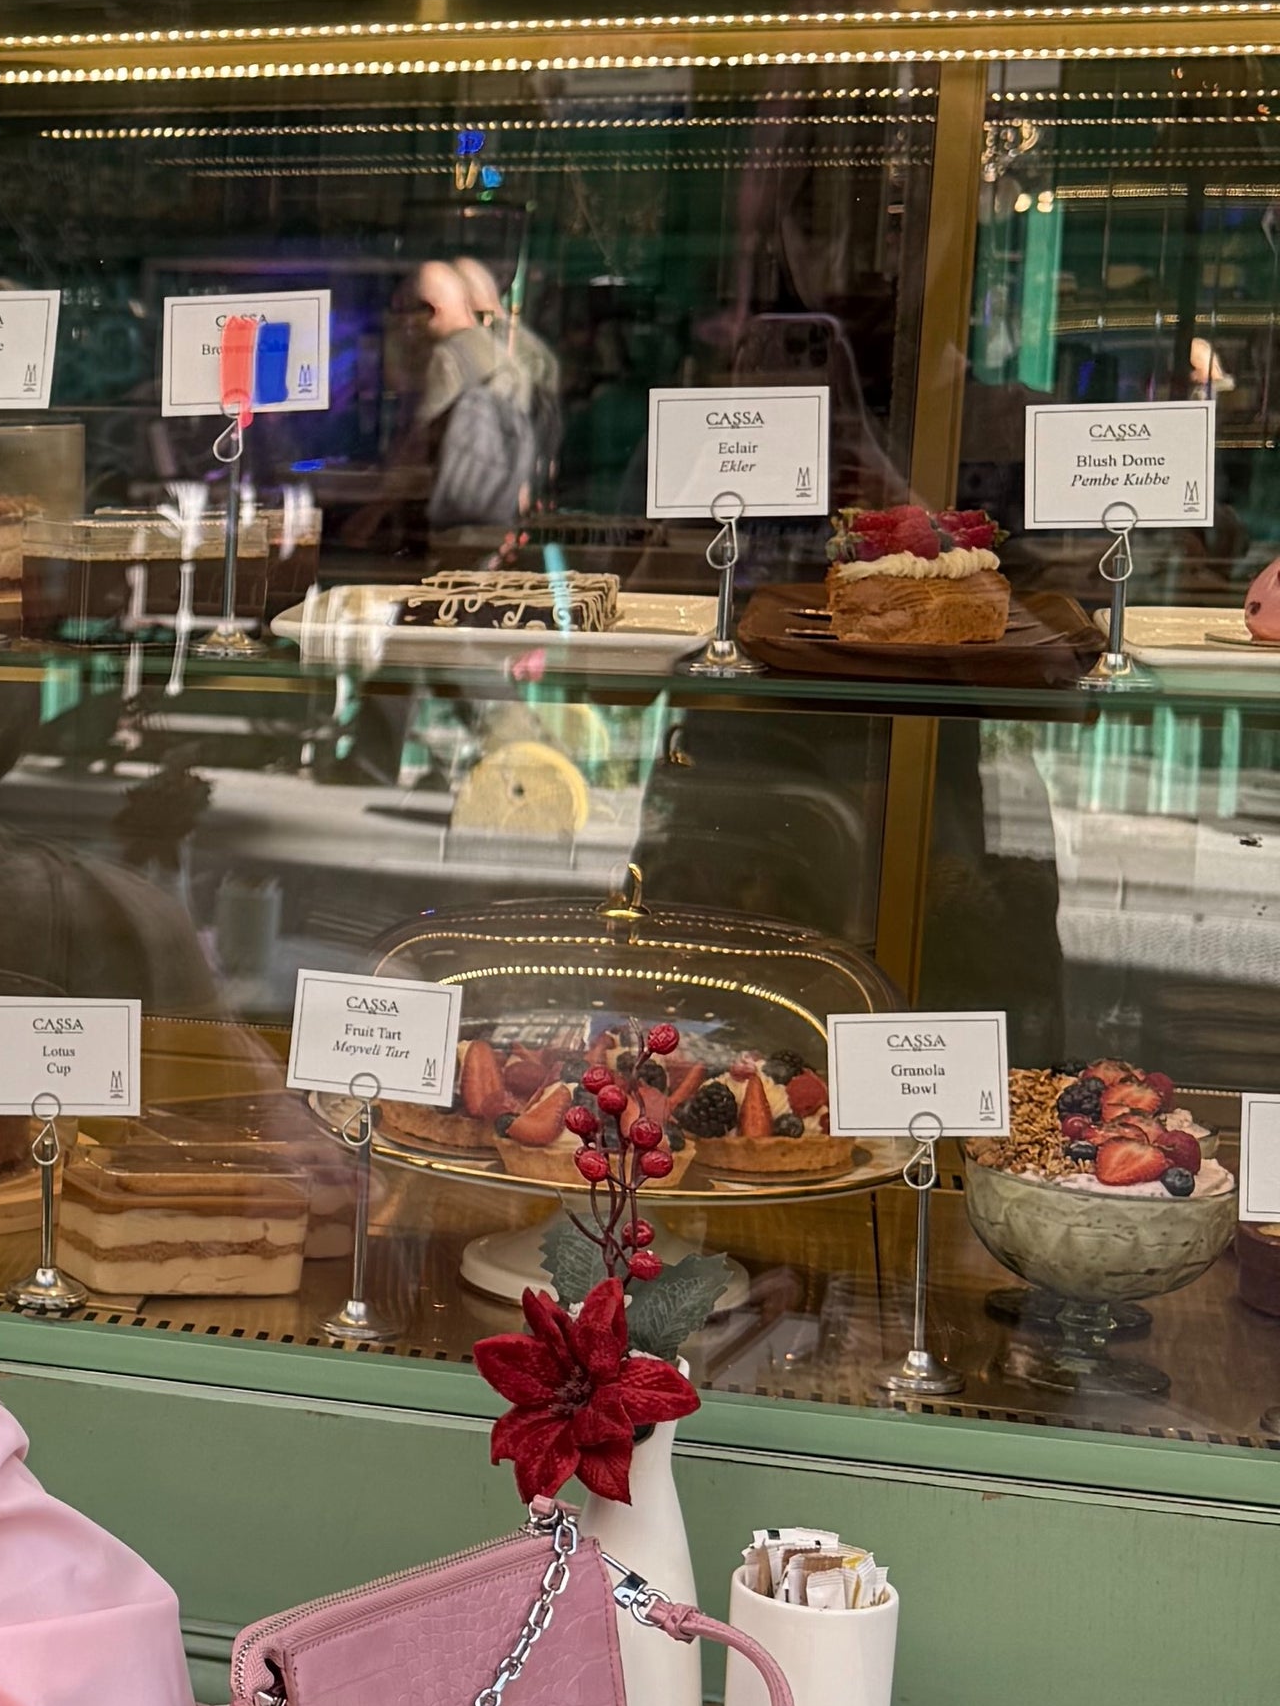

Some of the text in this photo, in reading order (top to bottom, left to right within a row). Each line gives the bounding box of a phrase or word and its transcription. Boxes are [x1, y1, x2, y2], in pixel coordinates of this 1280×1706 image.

[706, 411, 765, 429] CASSA
[1089, 423, 1151, 441] CASSA
[718, 442, 758, 454] Eclair
[719, 460, 756, 473] Ekler
[1076, 454, 1166, 467] Blush Dome
[1071, 472, 1170, 487] Pembe Kubbe
[346, 996, 399, 1015] CASSA
[32, 1018, 84, 1034] CASSA
[344, 1023, 402, 1041] Fruit Tart
[333, 1040, 410, 1059] Meyveli Tart
[886, 1034, 947, 1052] CASSA
[42, 1045, 76, 1057] Lotus
[46, 1062, 71, 1076] Cup
[891, 1064, 945, 1076] Granola
[901, 1082, 937, 1095] Bowl
